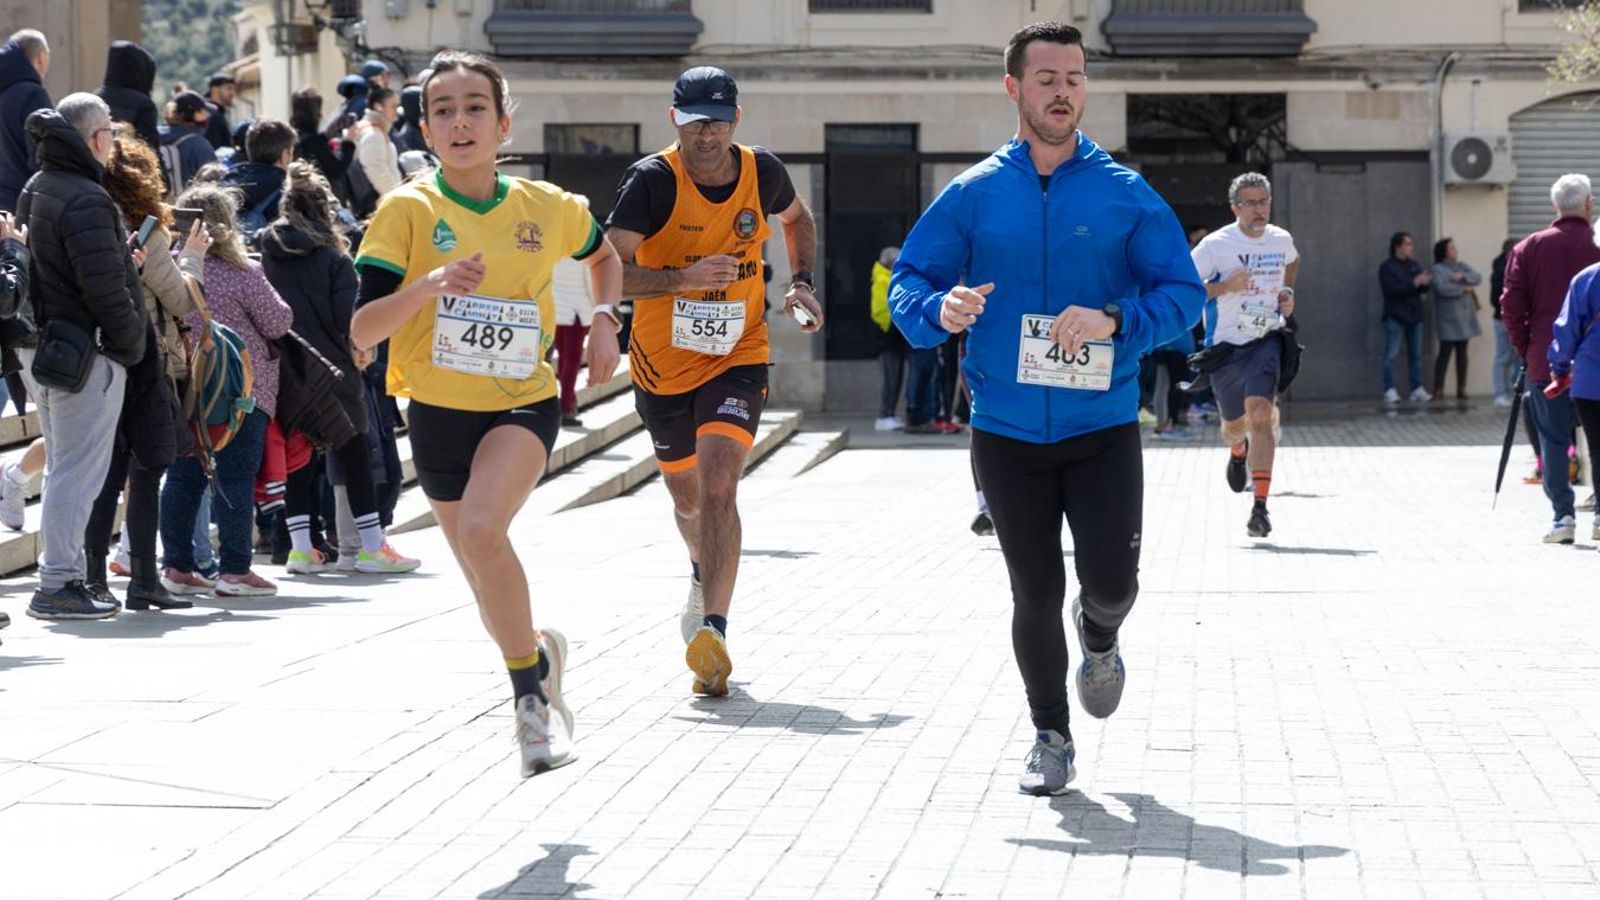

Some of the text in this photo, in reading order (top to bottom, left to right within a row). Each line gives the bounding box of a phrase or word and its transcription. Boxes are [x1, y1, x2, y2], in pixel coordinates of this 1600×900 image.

[442, 296, 456, 312] V
[677, 301, 686, 312] V
[692, 320, 727, 337] 554
[460, 324, 513, 351] 489
